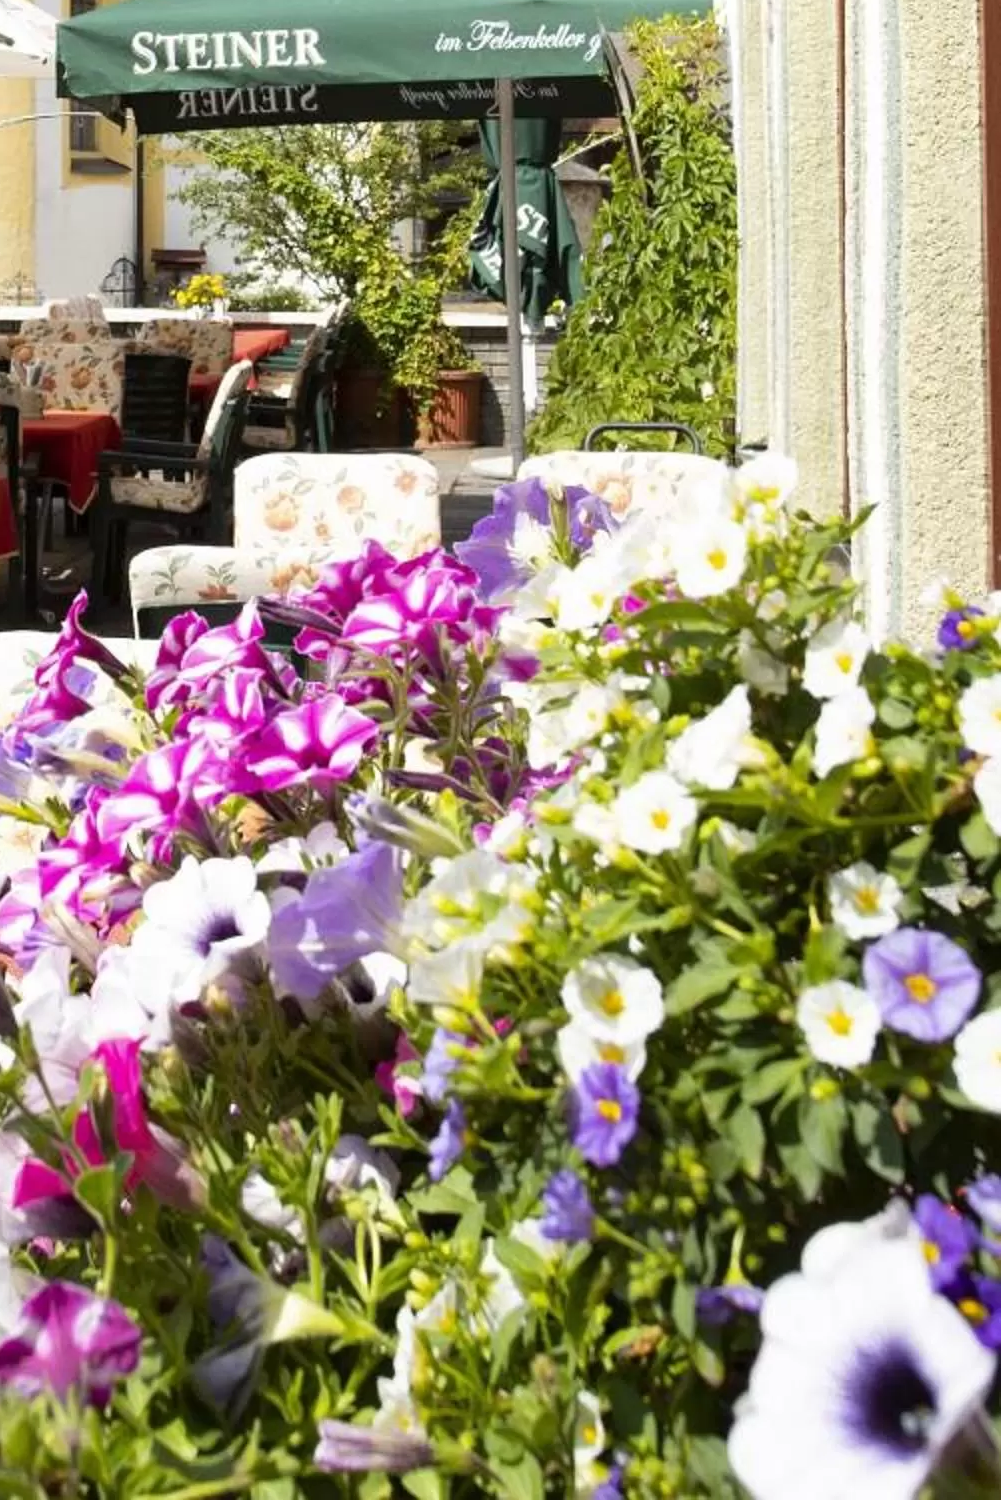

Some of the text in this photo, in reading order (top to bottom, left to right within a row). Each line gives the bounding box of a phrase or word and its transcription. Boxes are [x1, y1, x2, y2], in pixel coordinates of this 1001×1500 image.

[130, 28, 327, 75] STEINER
[434, 32, 463, 52] im
[466, 19, 586, 51] Felsenkeller
